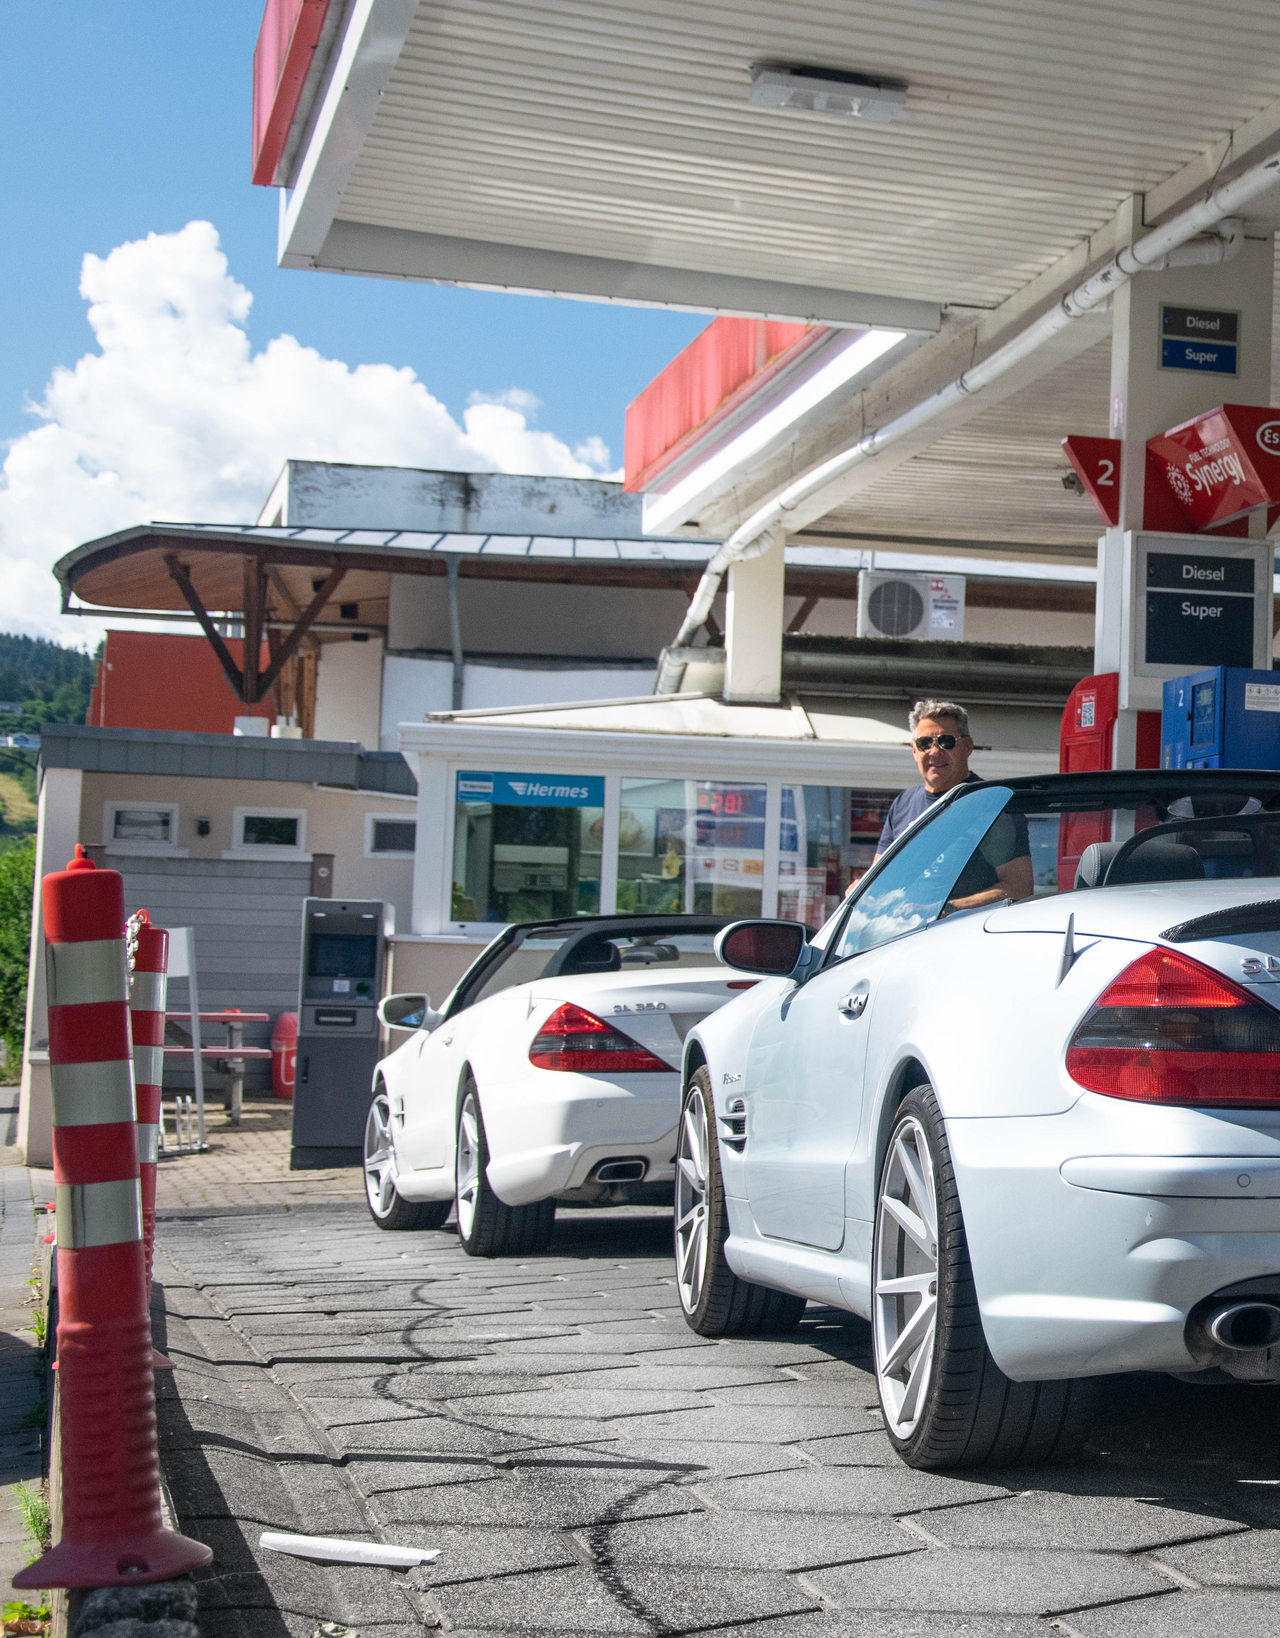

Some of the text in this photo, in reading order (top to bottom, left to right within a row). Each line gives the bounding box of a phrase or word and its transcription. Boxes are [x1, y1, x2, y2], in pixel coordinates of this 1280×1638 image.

[1186, 316, 1220, 331] Diesel
[1185, 348, 1218, 364] Super
[1188, 448, 1203, 463] FUEL
[1097, 459, 1114, 486] 2
[1185, 452, 1246, 496] Synergy
[1182, 565, 1224, 581] Diesel
[1181, 601, 1223, 620] Super
[1178, 689, 1184, 707] 2
[525, 782, 589, 799] Hermes
